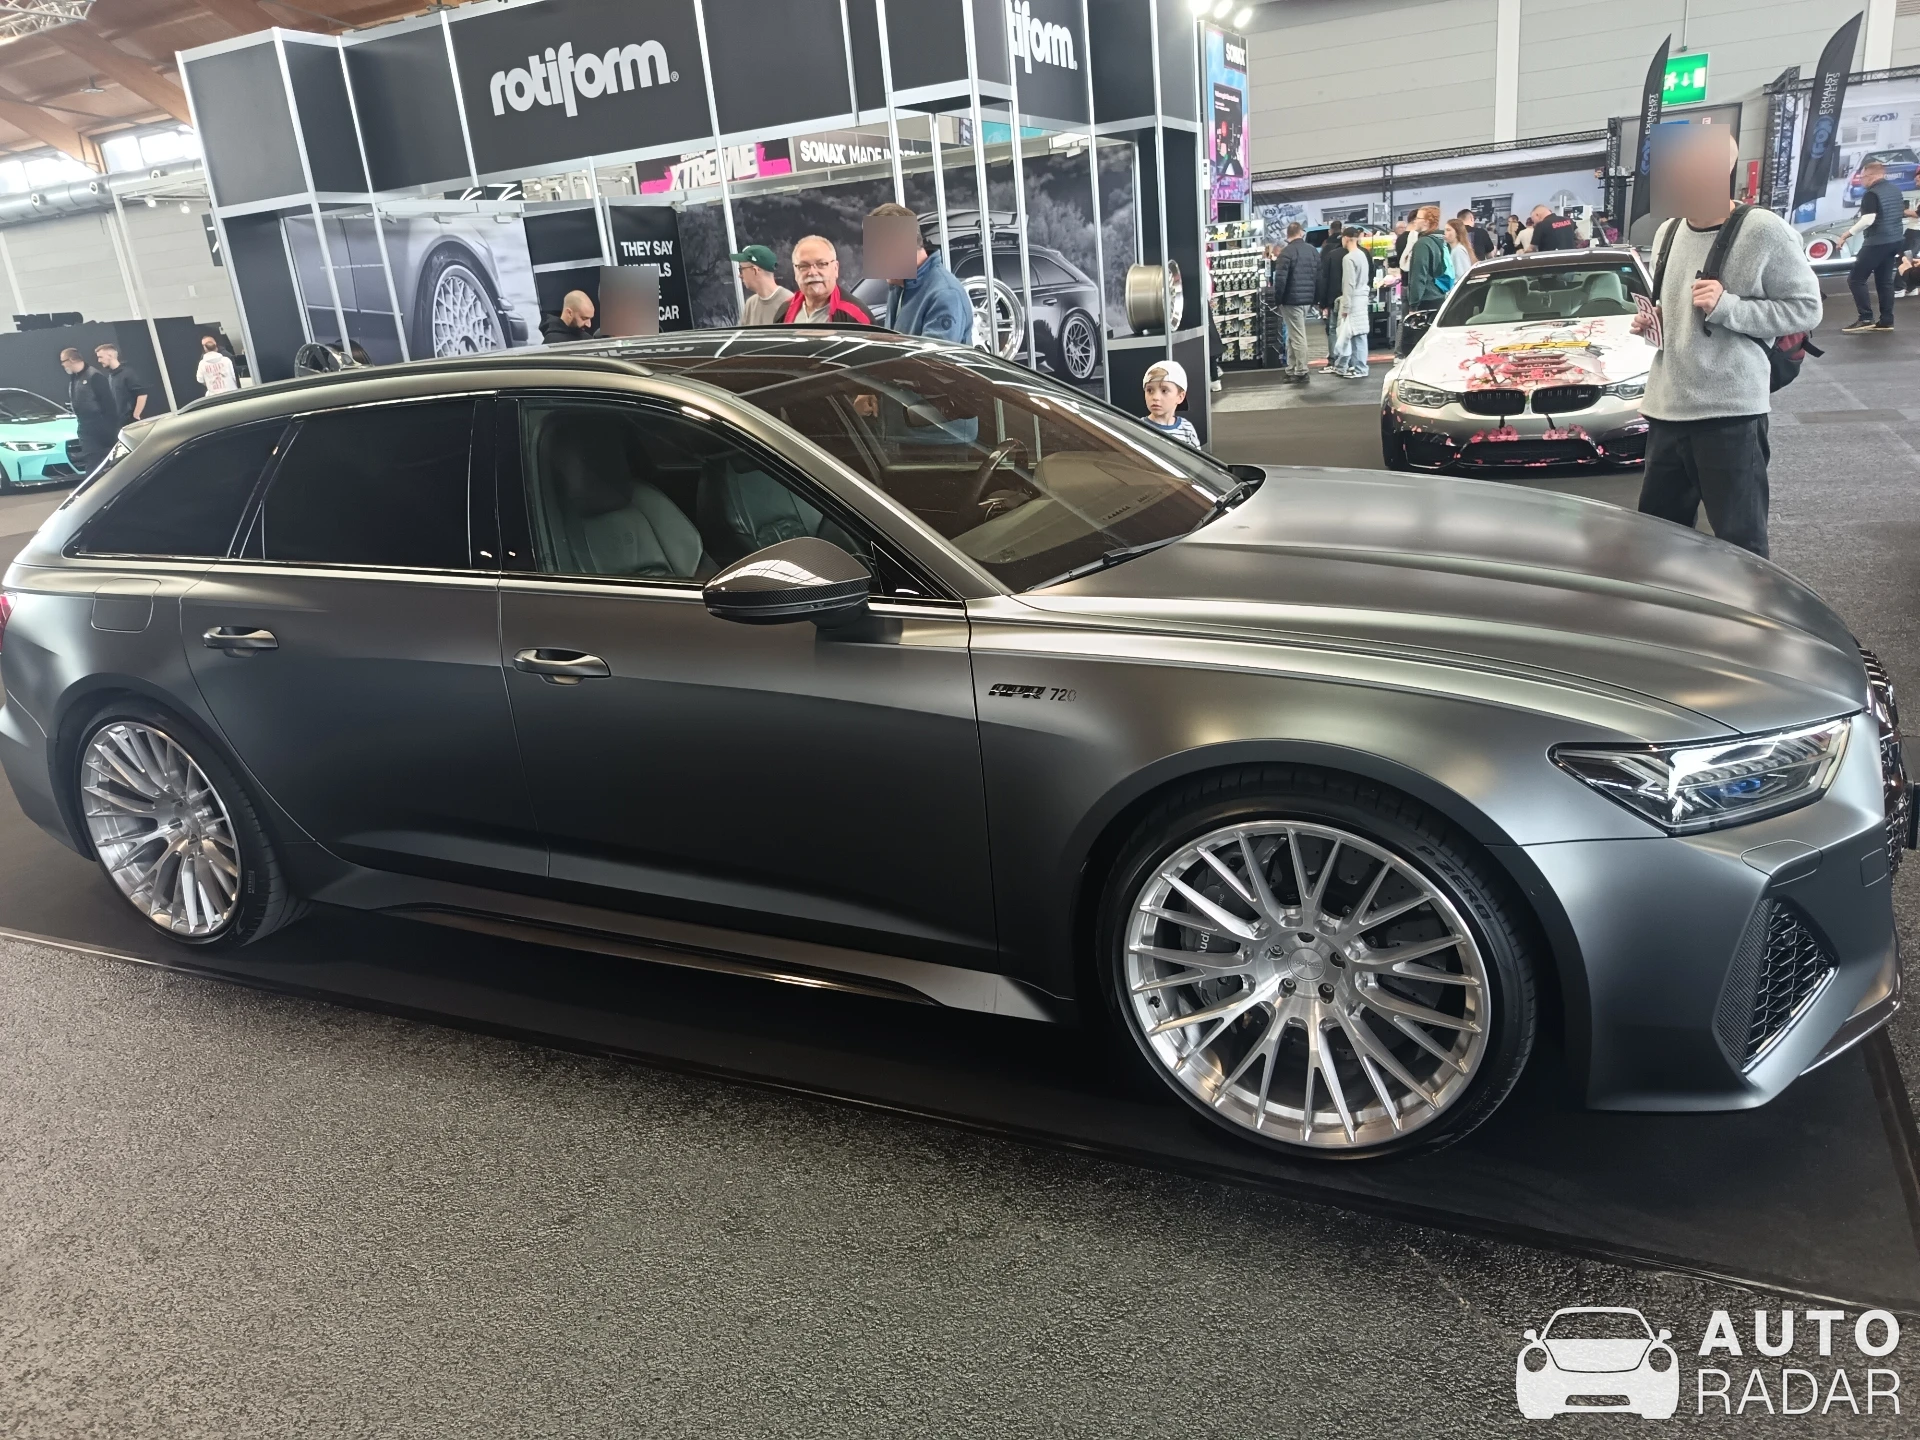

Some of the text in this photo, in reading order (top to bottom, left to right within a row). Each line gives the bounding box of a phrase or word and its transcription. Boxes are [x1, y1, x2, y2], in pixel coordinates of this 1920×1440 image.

[1006, 0, 1075, 74] tiform
[489, 41, 671, 118] rotiform
[1818, 72, 1834, 116] EXHAUST
[1824, 72, 1841, 114] SYSTEMS
[1644, 93, 1658, 135] EXHAUST
[800, 139, 846, 165] SONAX
[850, 144, 883, 165] MADE
[620, 240, 674, 257] THEY SAY
[658, 305, 680, 321] CAR
[1049, 687, 1077, 702] 720
[1415, 845, 1492, 920] P ZERO
[1197, 930, 1210, 953] udi
